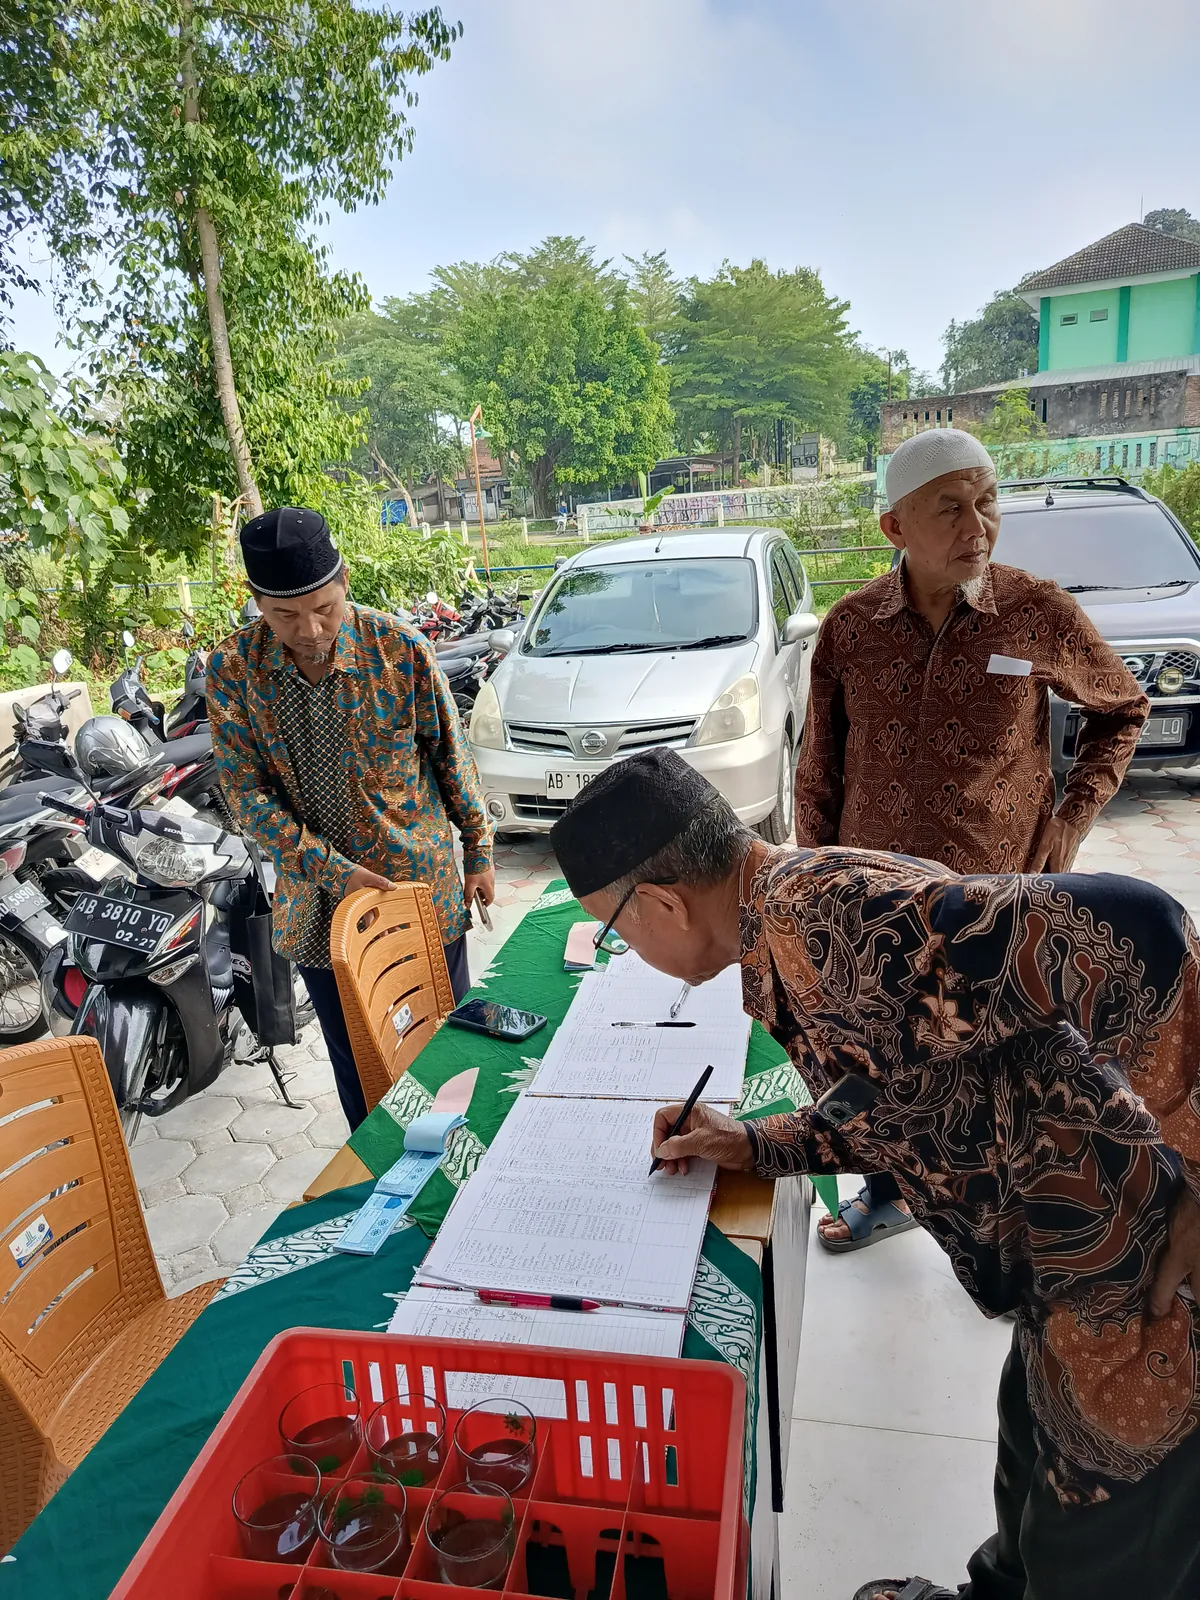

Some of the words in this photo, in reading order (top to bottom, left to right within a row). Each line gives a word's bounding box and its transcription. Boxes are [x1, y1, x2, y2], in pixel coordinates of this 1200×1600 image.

[1161, 719, 1181, 735] LQ
[548, 773, 563, 789] AB
[163, 827, 196, 840] HONDA
[8, 886, 35, 907] 5990
[76, 897, 98, 915] AB
[101, 903, 142, 925] 3810
